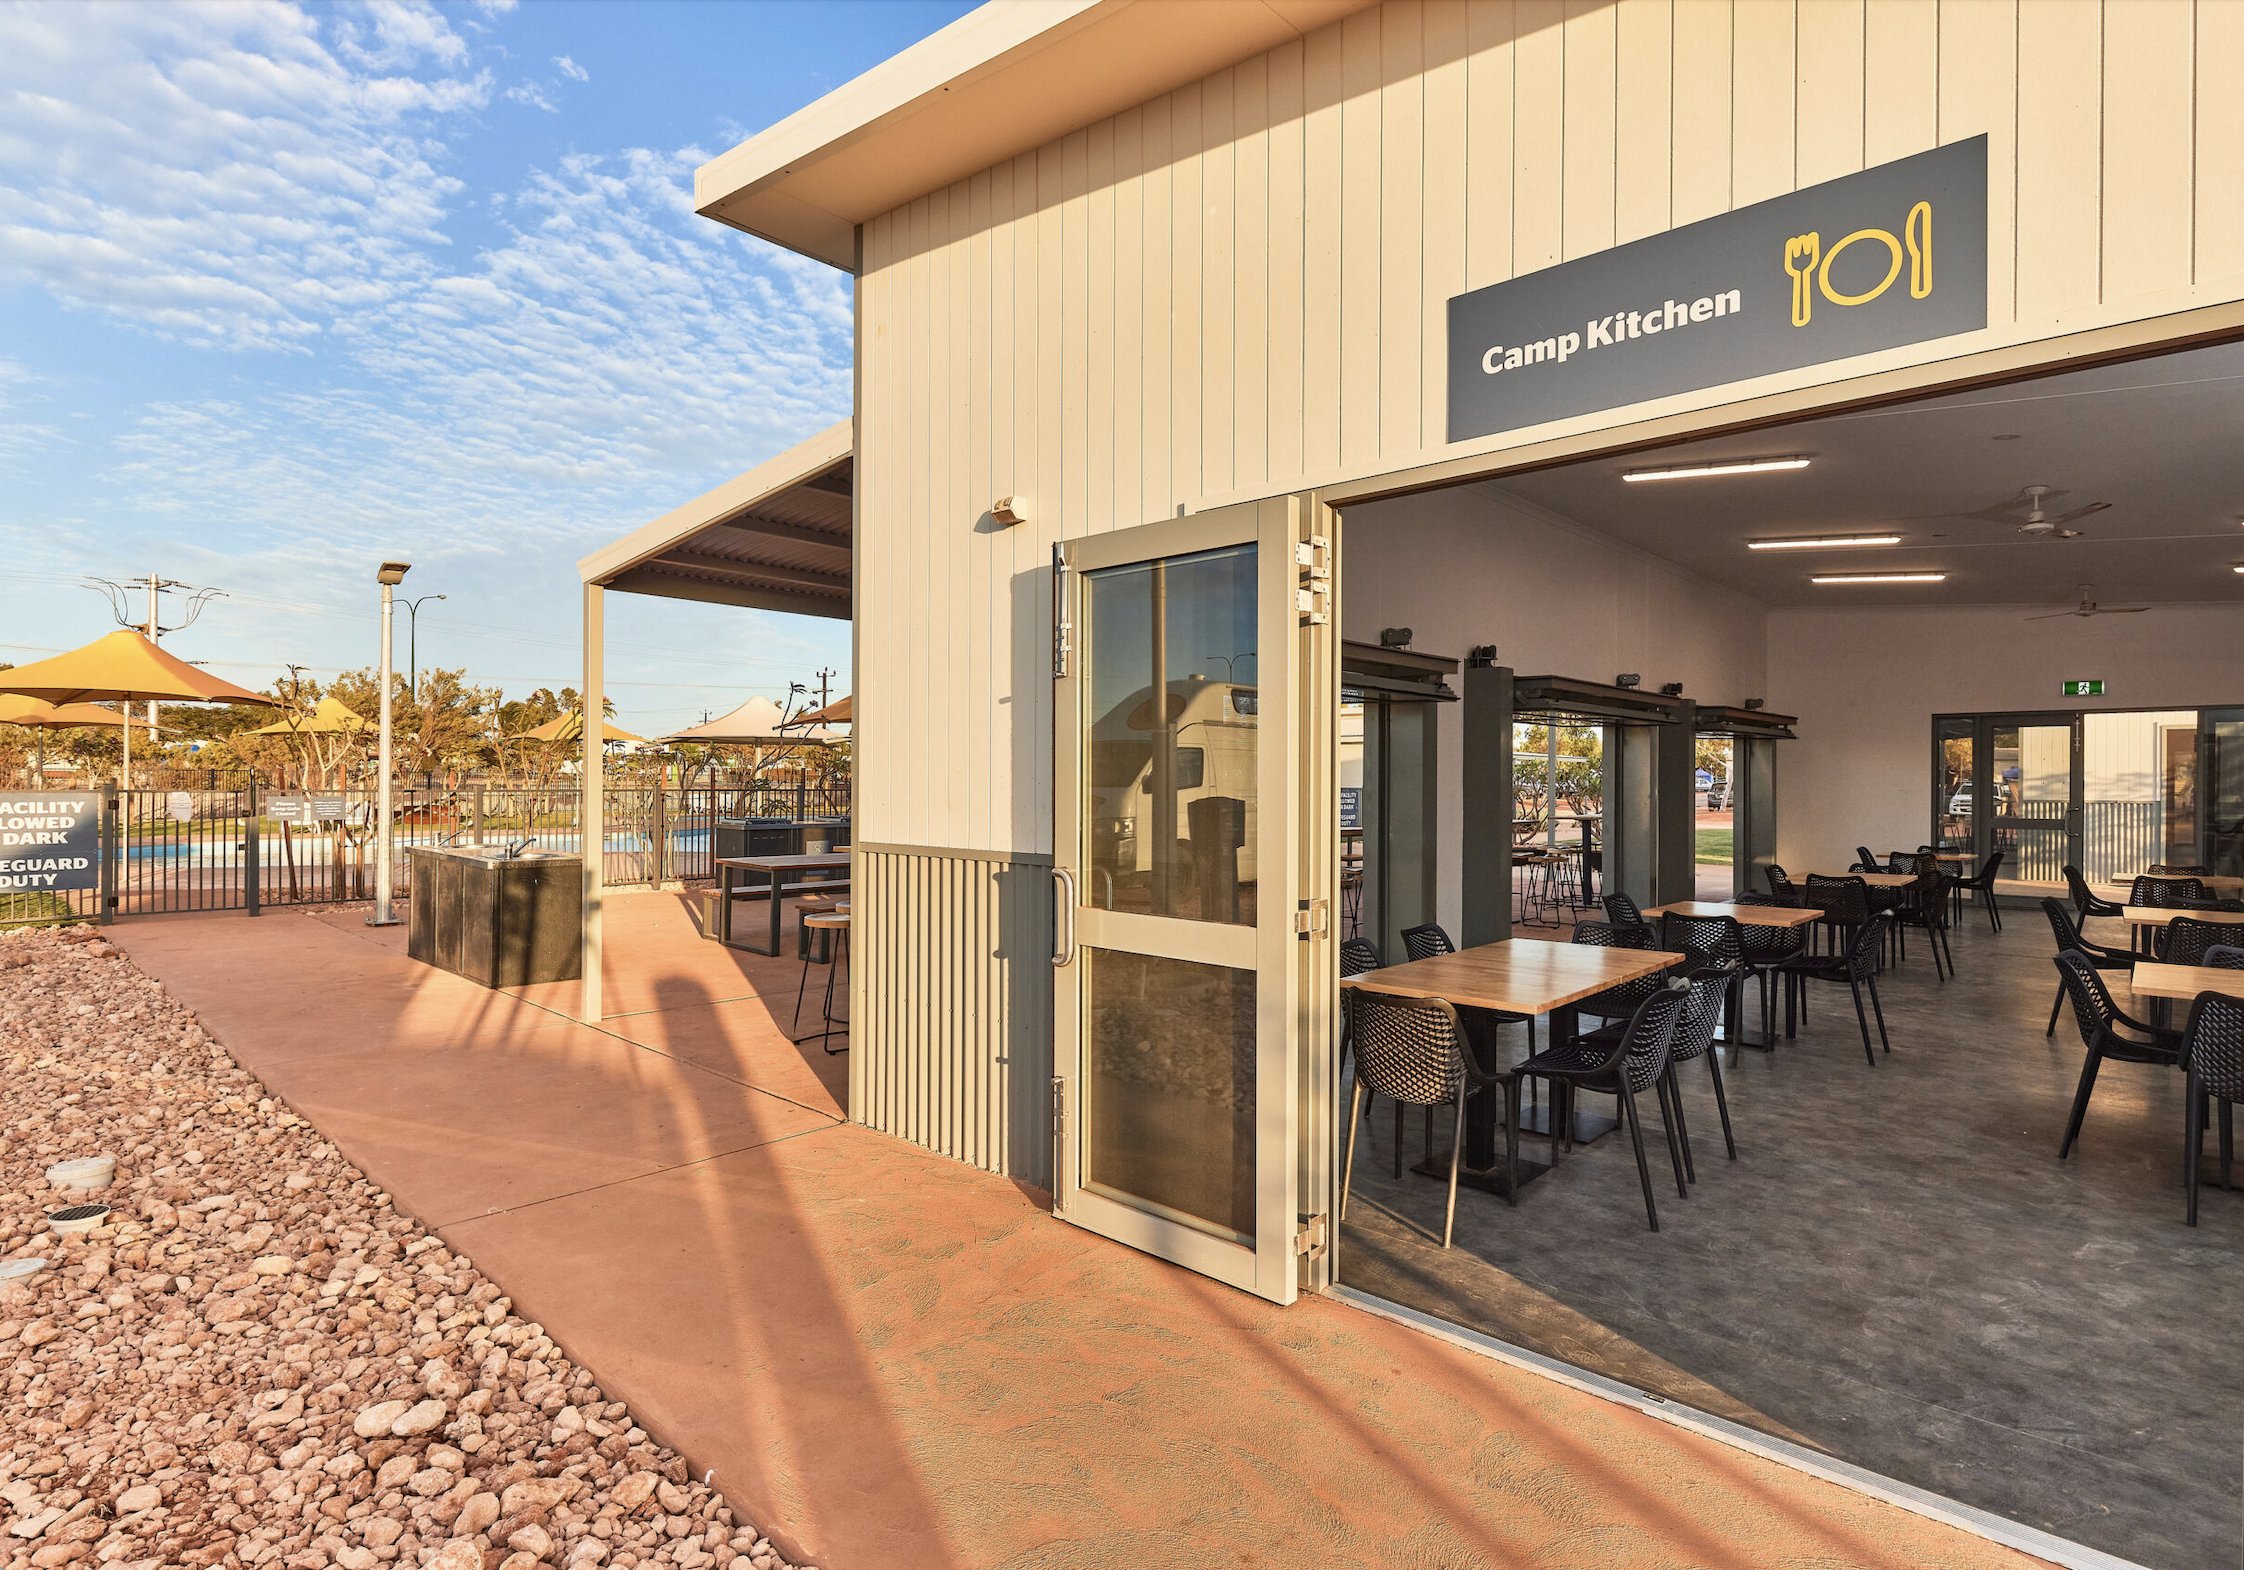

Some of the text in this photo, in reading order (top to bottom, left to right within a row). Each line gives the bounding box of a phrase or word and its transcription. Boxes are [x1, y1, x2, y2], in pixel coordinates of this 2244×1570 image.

[1481, 288, 1742, 375] Camp Kitchen
[0, 801, 85, 814] ACILITY
[0, 816, 76, 830] LOWED
[2, 831, 69, 846] DARK
[0, 857, 89, 872] EGUARD
[0, 873, 58, 888] DUTY
